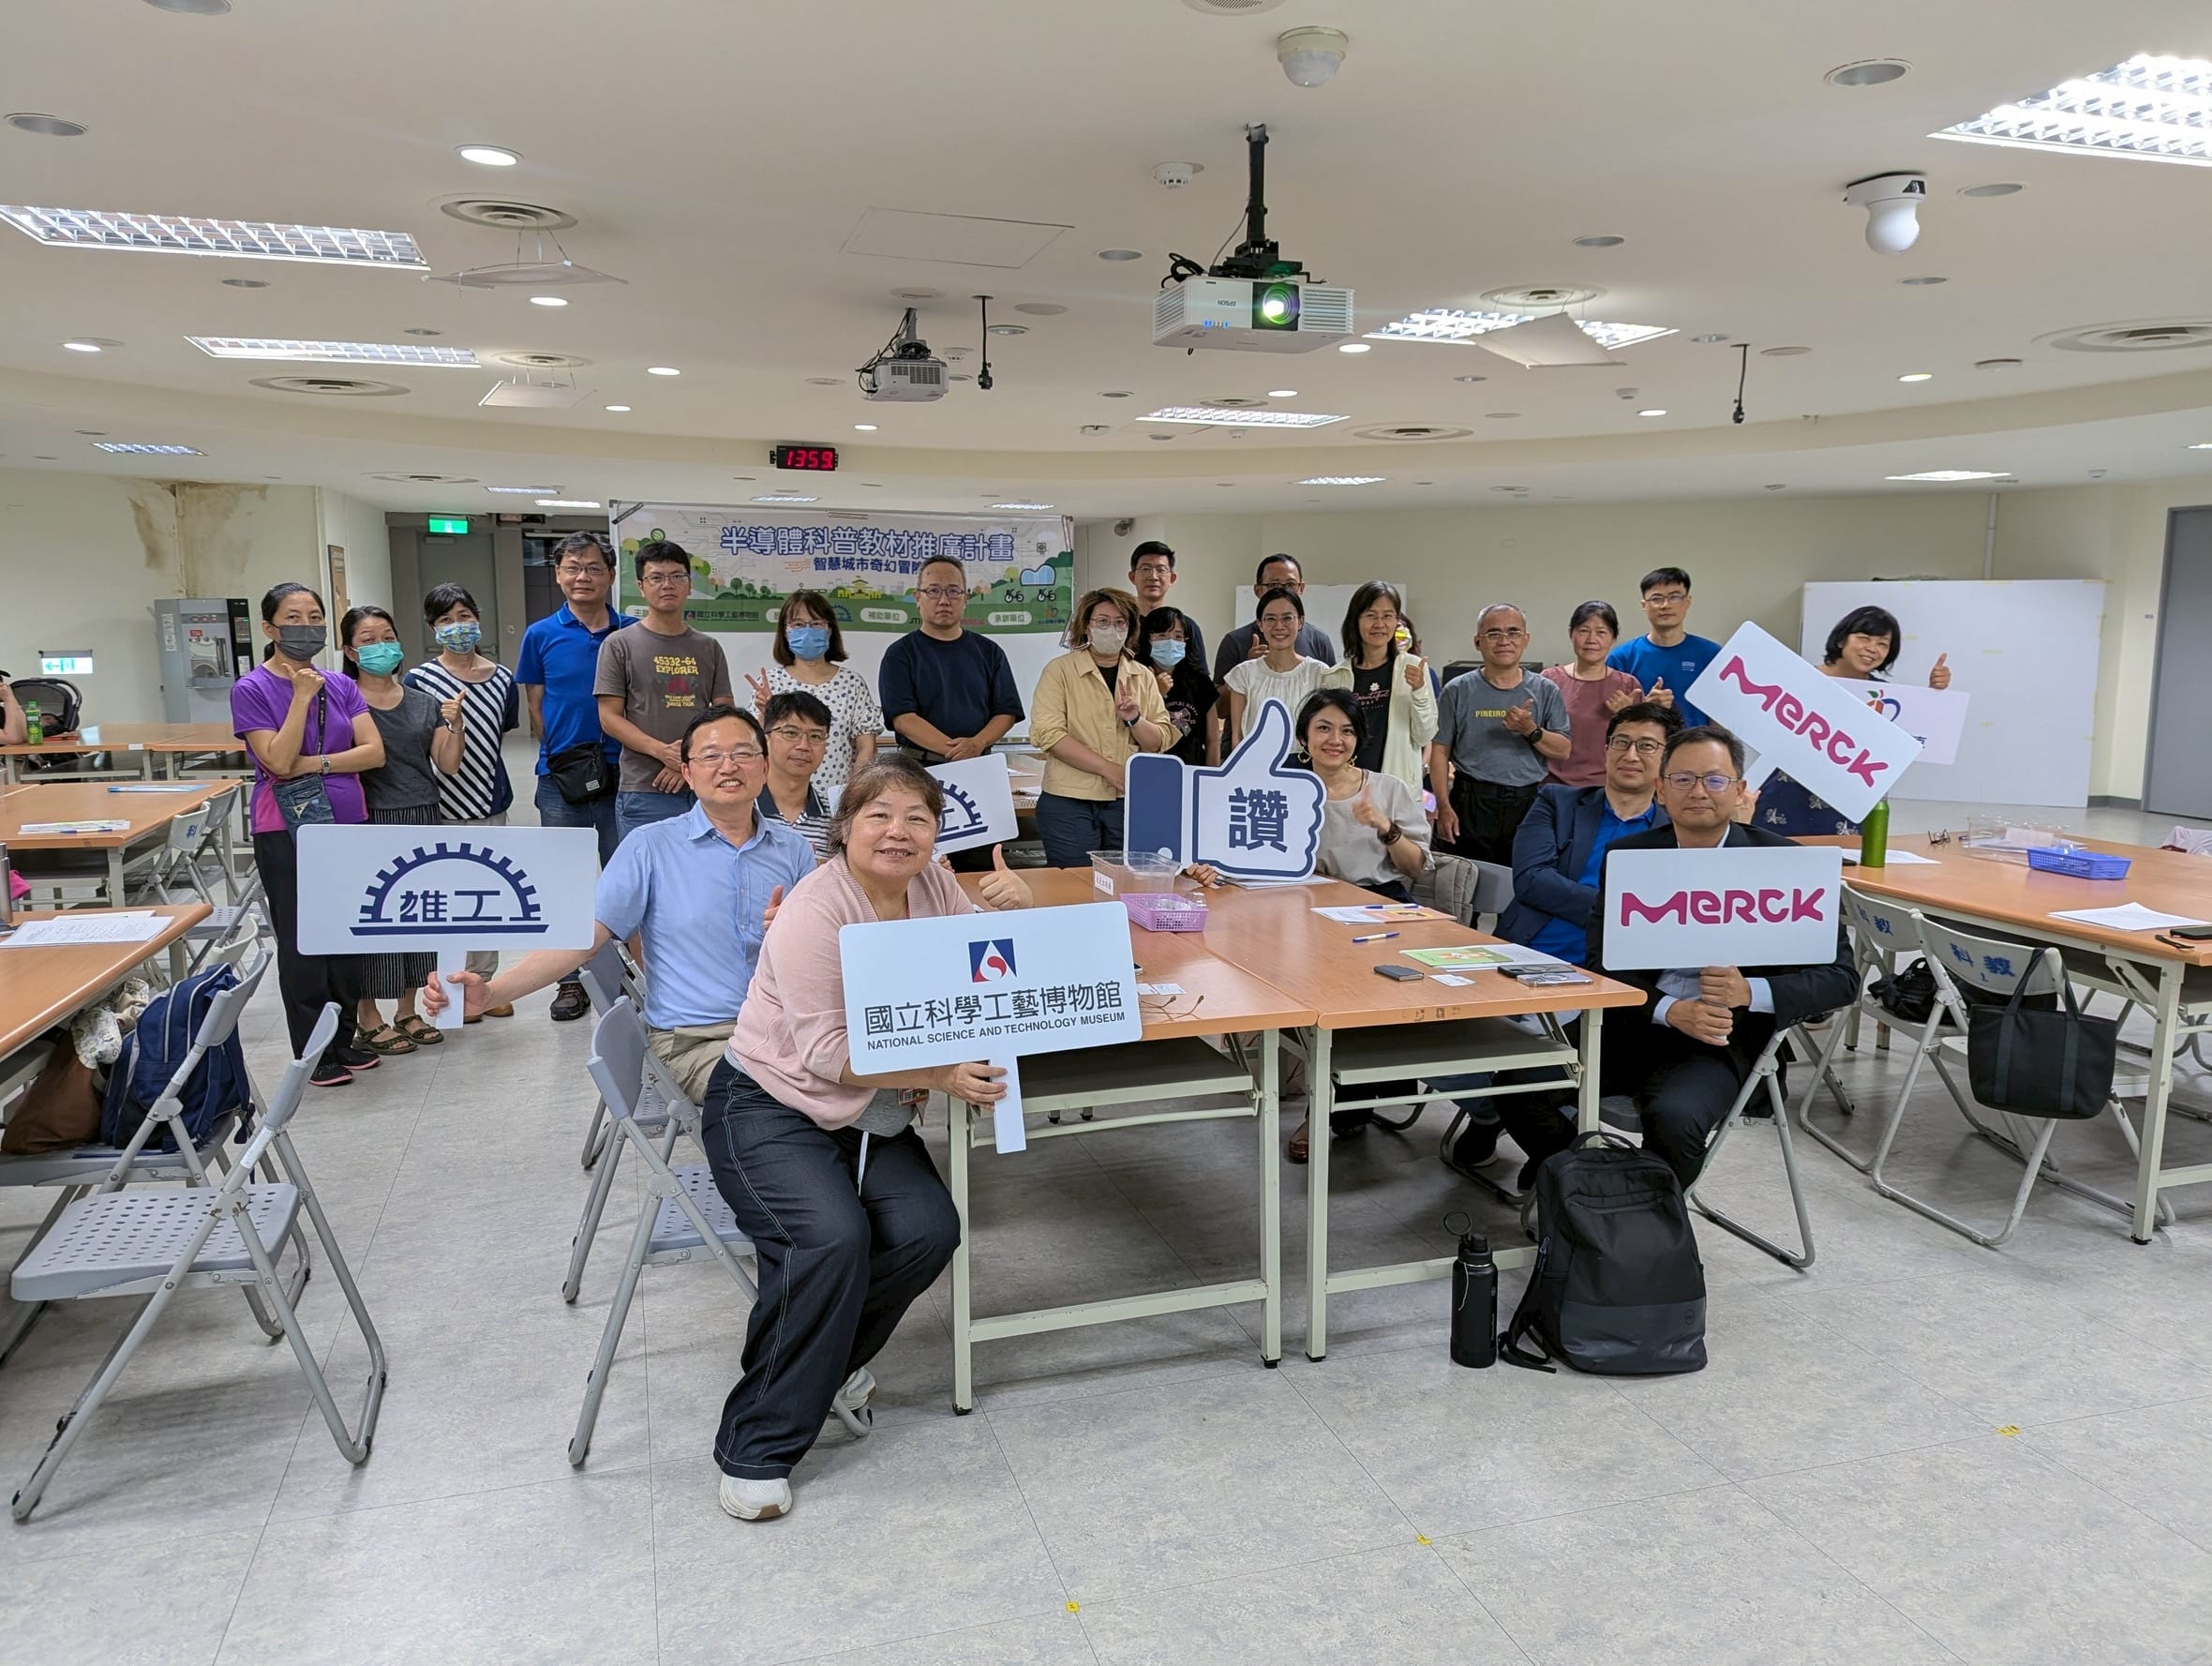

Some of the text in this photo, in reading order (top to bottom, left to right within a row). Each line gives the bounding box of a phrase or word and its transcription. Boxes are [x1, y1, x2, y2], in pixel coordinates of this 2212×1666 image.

[720, 526, 1014, 561] 半導體科普教材推廣計畫
[867, 610, 901, 621] 補助單位
[994, 613, 1025, 623] 承辦單位
[653, 655, 696, 667] 45332-64
[656, 665, 699, 675] EXPLORER
[1474, 709, 1506, 718] PINEIRO
[1228, 787, 1289, 853] 讚
[399, 890, 503, 923] 雄工
[1949, 942, 2016, 978] 科教
[864, 980, 1123, 1036] 國立科學工藝博物館
[867, 1012, 1126, 1050] NATIONAL SCIENCE AND TECHNOLOGY MUSEUM
